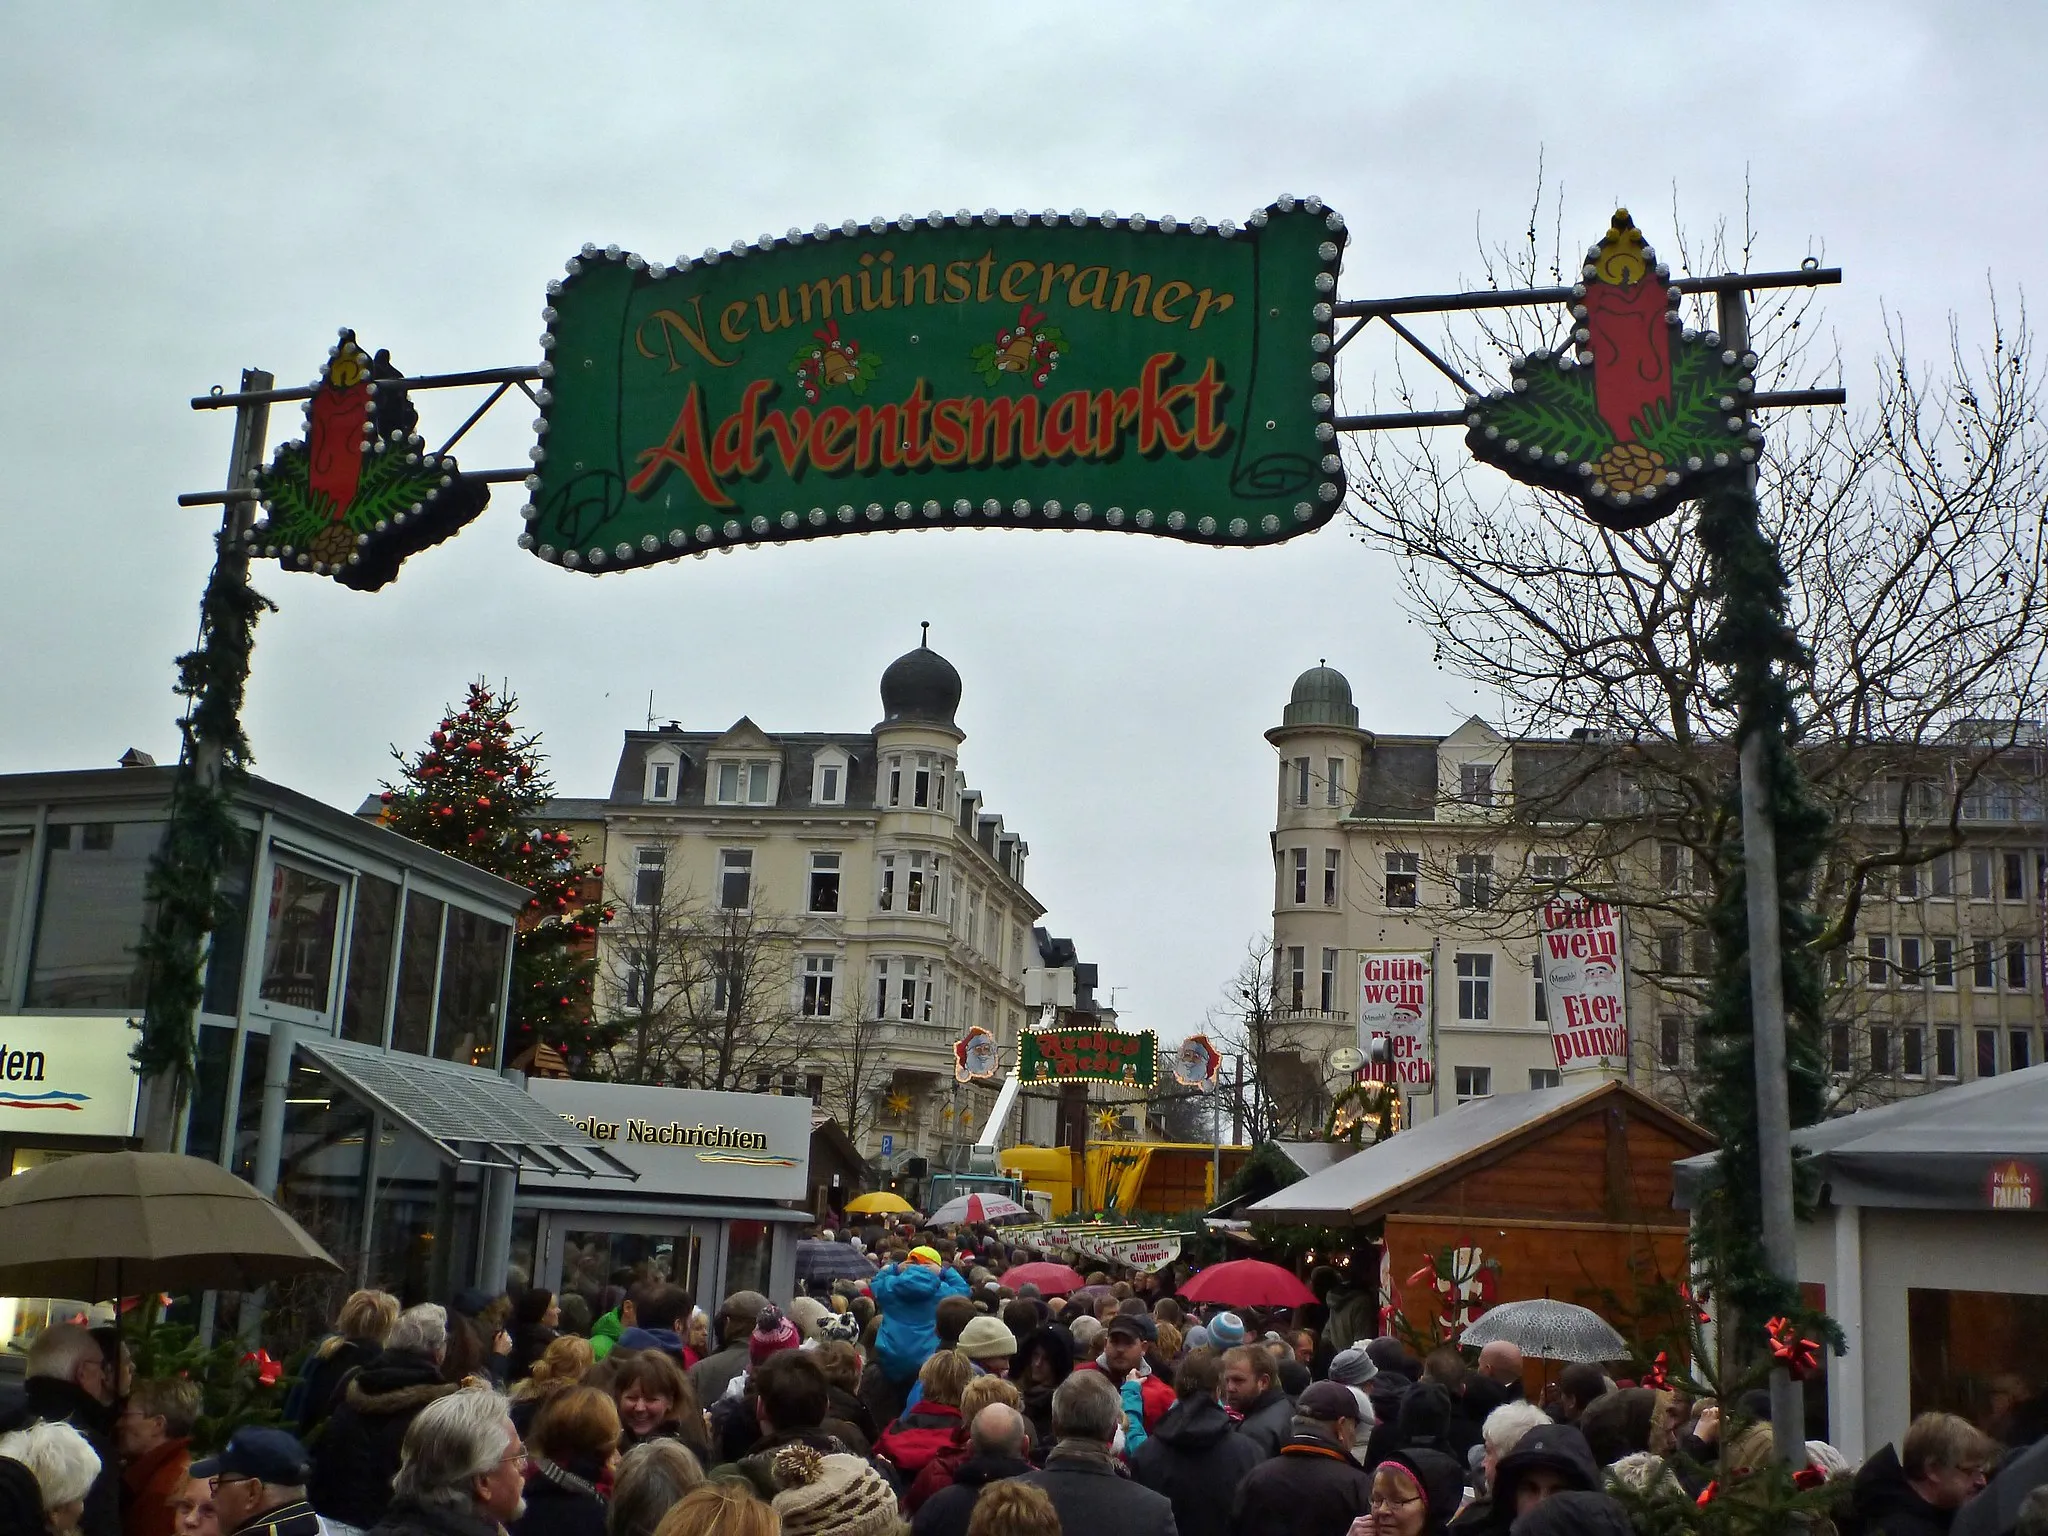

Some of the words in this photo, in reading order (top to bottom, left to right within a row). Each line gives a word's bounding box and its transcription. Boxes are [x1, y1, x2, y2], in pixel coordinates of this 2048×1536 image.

[635, 248, 1234, 373] Neumünsteraner
[627, 352, 1228, 507] Adventsmarkt
[1547, 929, 1617, 960] wein
[1364, 958, 1431, 981] Glüh-
[1364, 982, 1424, 1004] wein
[1562, 993, 1622, 1028] Eier-
[1371, 1031, 1422, 1058] er-
[1553, 1023, 1628, 1066] punsch
[627, 1119, 768, 1150] Nachrichten
[883, 1138, 890, 1151] P
[986, 1203, 1017, 1216] PING
[1993, 1186, 2031, 1208] PALAIS
[1130, 1251, 1169, 1263] Glühwein
[1136, 1242, 1160, 1251] Heisser
